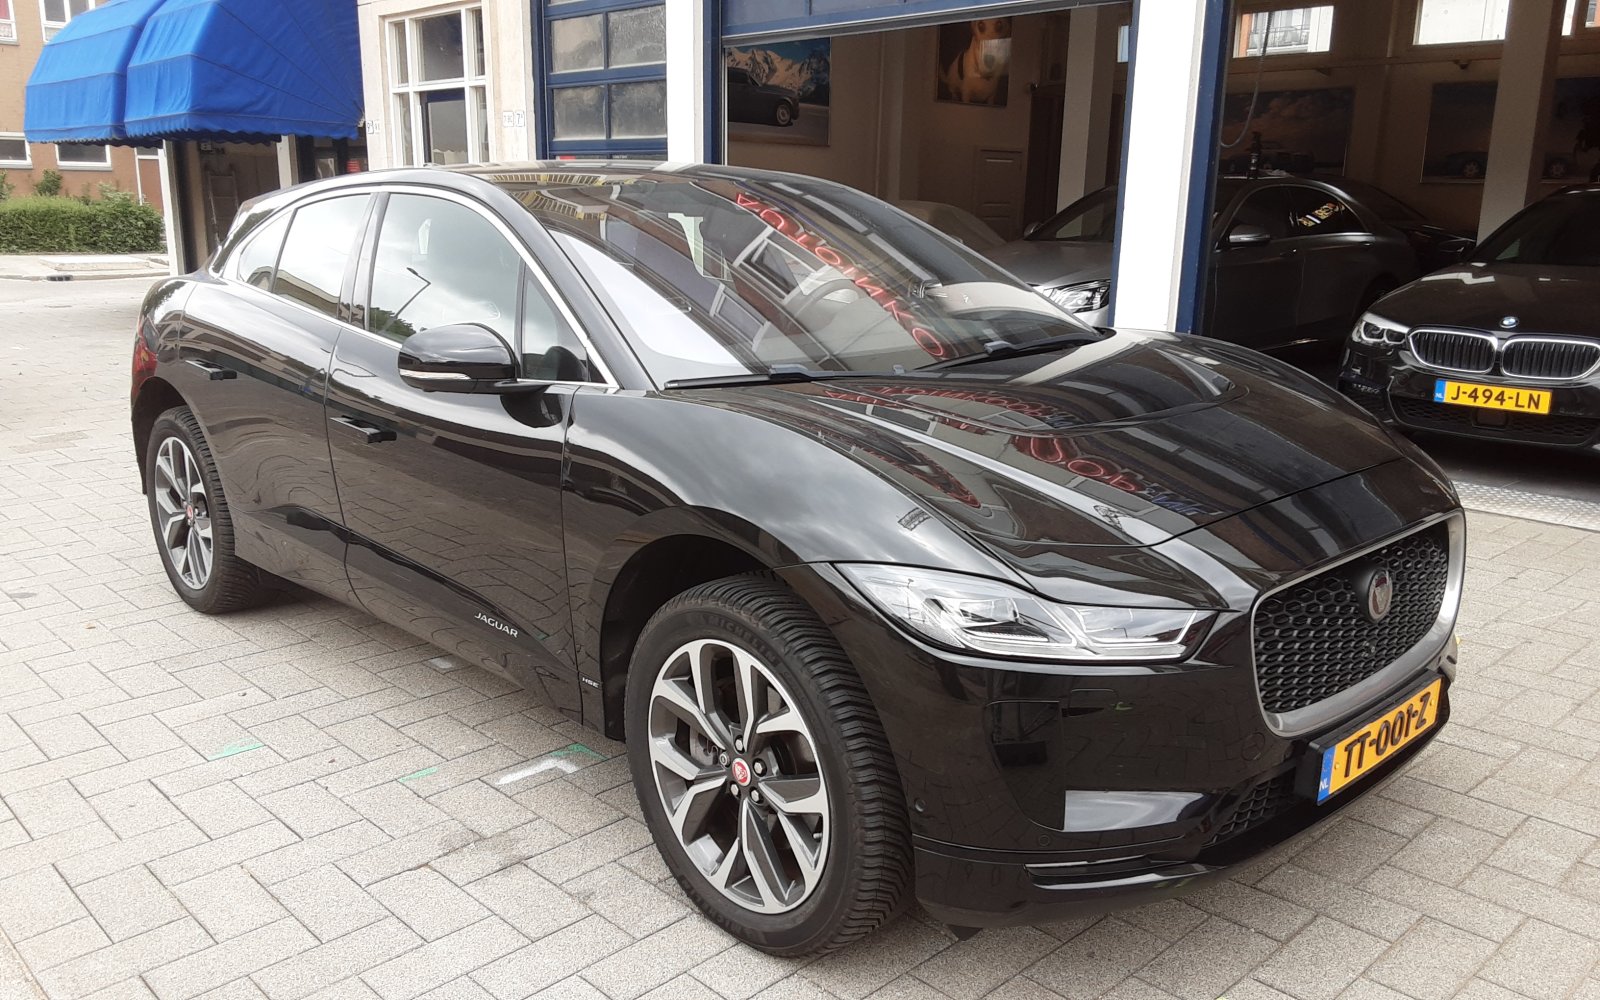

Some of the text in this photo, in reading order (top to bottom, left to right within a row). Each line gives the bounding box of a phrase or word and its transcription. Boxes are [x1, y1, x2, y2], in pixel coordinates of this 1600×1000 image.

[1451, 385, 1541, 410] J-494-LN
[474, 612, 519, 638] JAGUAR
[582, 676, 599, 689] HSE
[1319, 691, 1431, 792] NL TT-001-Z
